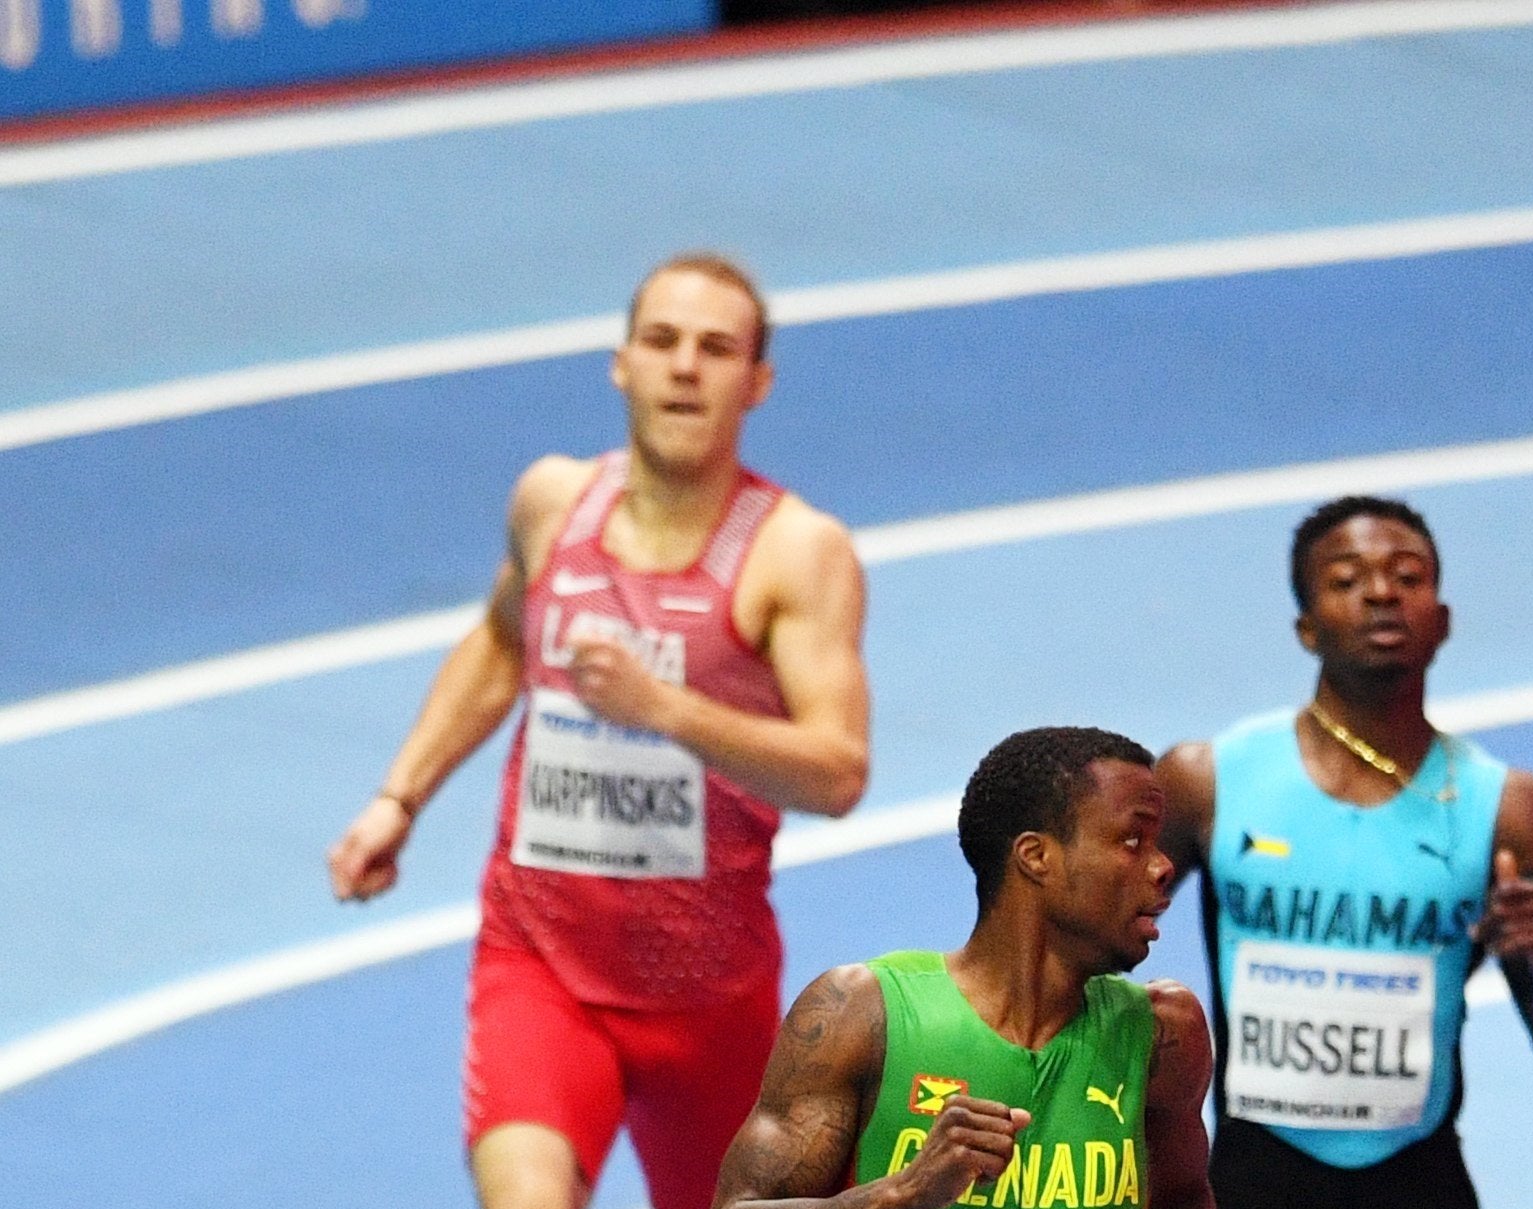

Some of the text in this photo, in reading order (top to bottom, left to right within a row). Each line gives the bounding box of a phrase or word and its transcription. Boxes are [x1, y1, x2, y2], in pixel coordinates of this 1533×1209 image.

[1224, 880, 1482, 948] BAHAMAS
[1248, 963, 1326, 989] TOYO
[1240, 1015, 1418, 1079] RUSSELL
[886, 1127, 1139, 1209] GNADA
